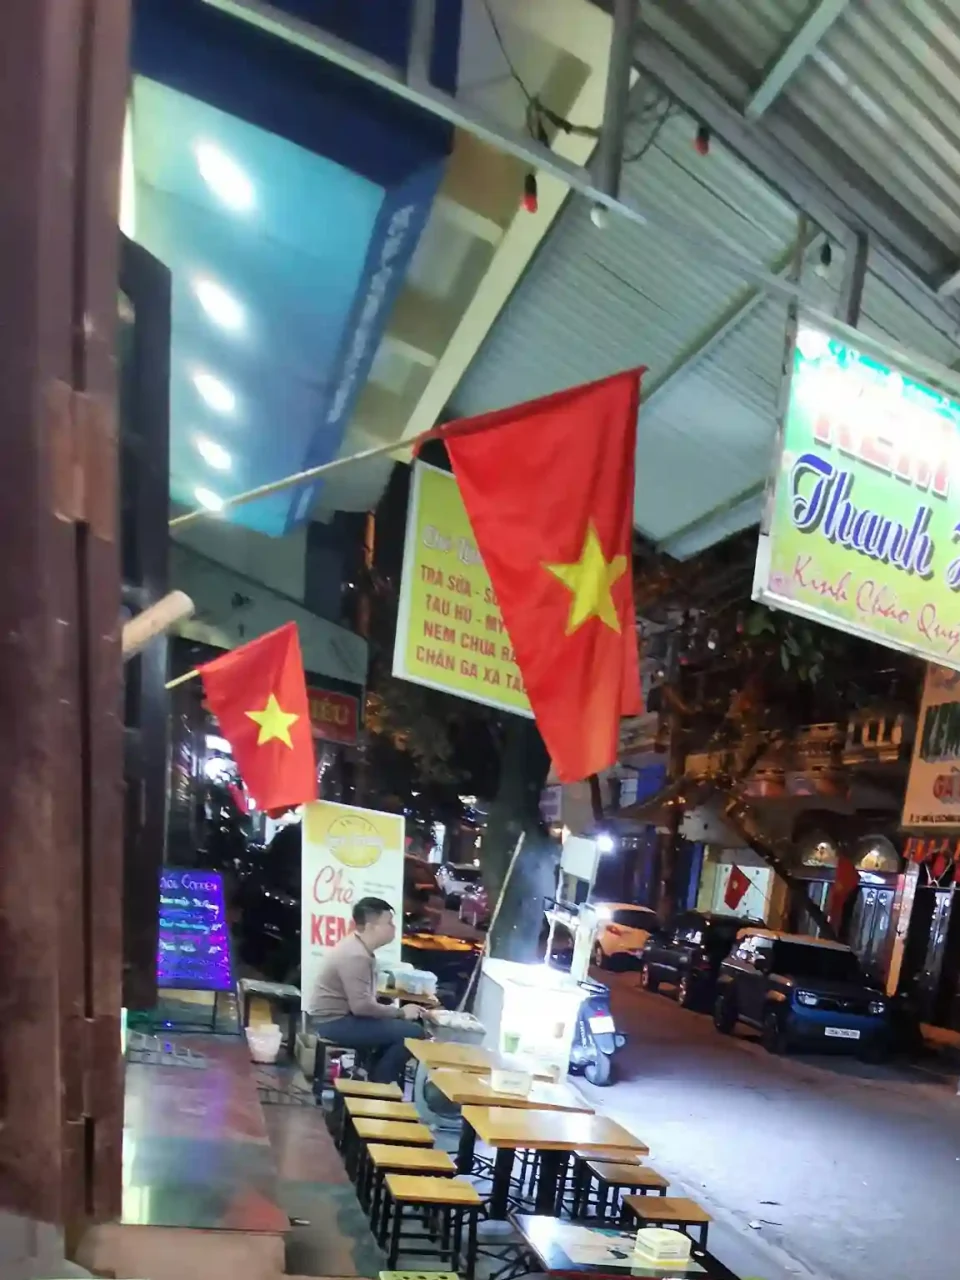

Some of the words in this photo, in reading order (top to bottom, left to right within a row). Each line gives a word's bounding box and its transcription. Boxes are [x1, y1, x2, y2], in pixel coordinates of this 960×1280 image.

[791, 453, 934, 580] Thanh
[424, 620, 456, 645] NEM
[461, 632, 496, 659] CHUA
[313, 865, 355, 905] Chè
